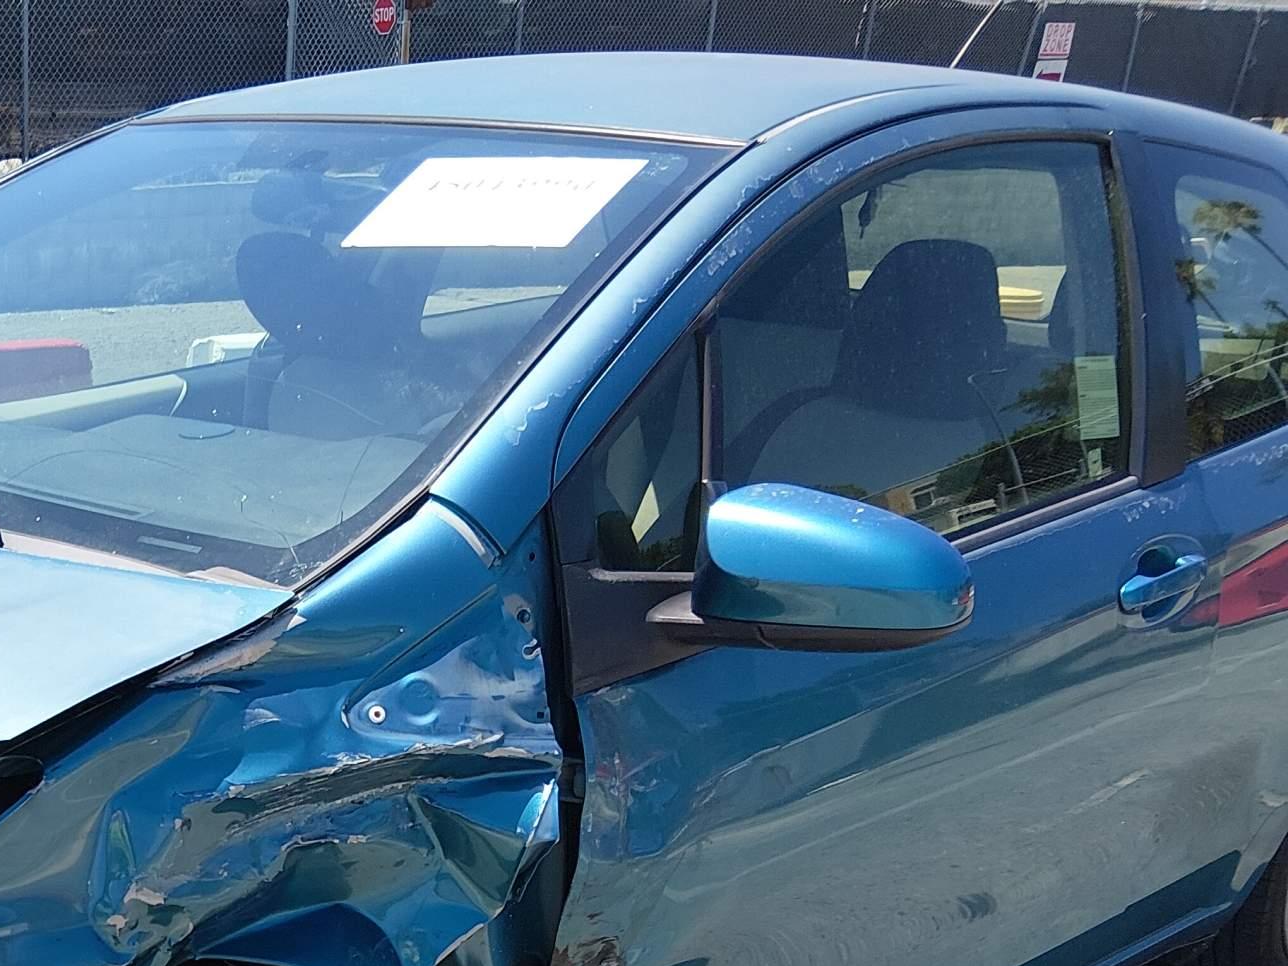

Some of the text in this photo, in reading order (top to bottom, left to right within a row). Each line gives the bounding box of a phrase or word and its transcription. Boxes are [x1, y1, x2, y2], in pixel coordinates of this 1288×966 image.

[375, 7, 394, 23] STOP
[1047, 23, 1073, 38] DROP
[1042, 38, 1070, 53] ZONE
